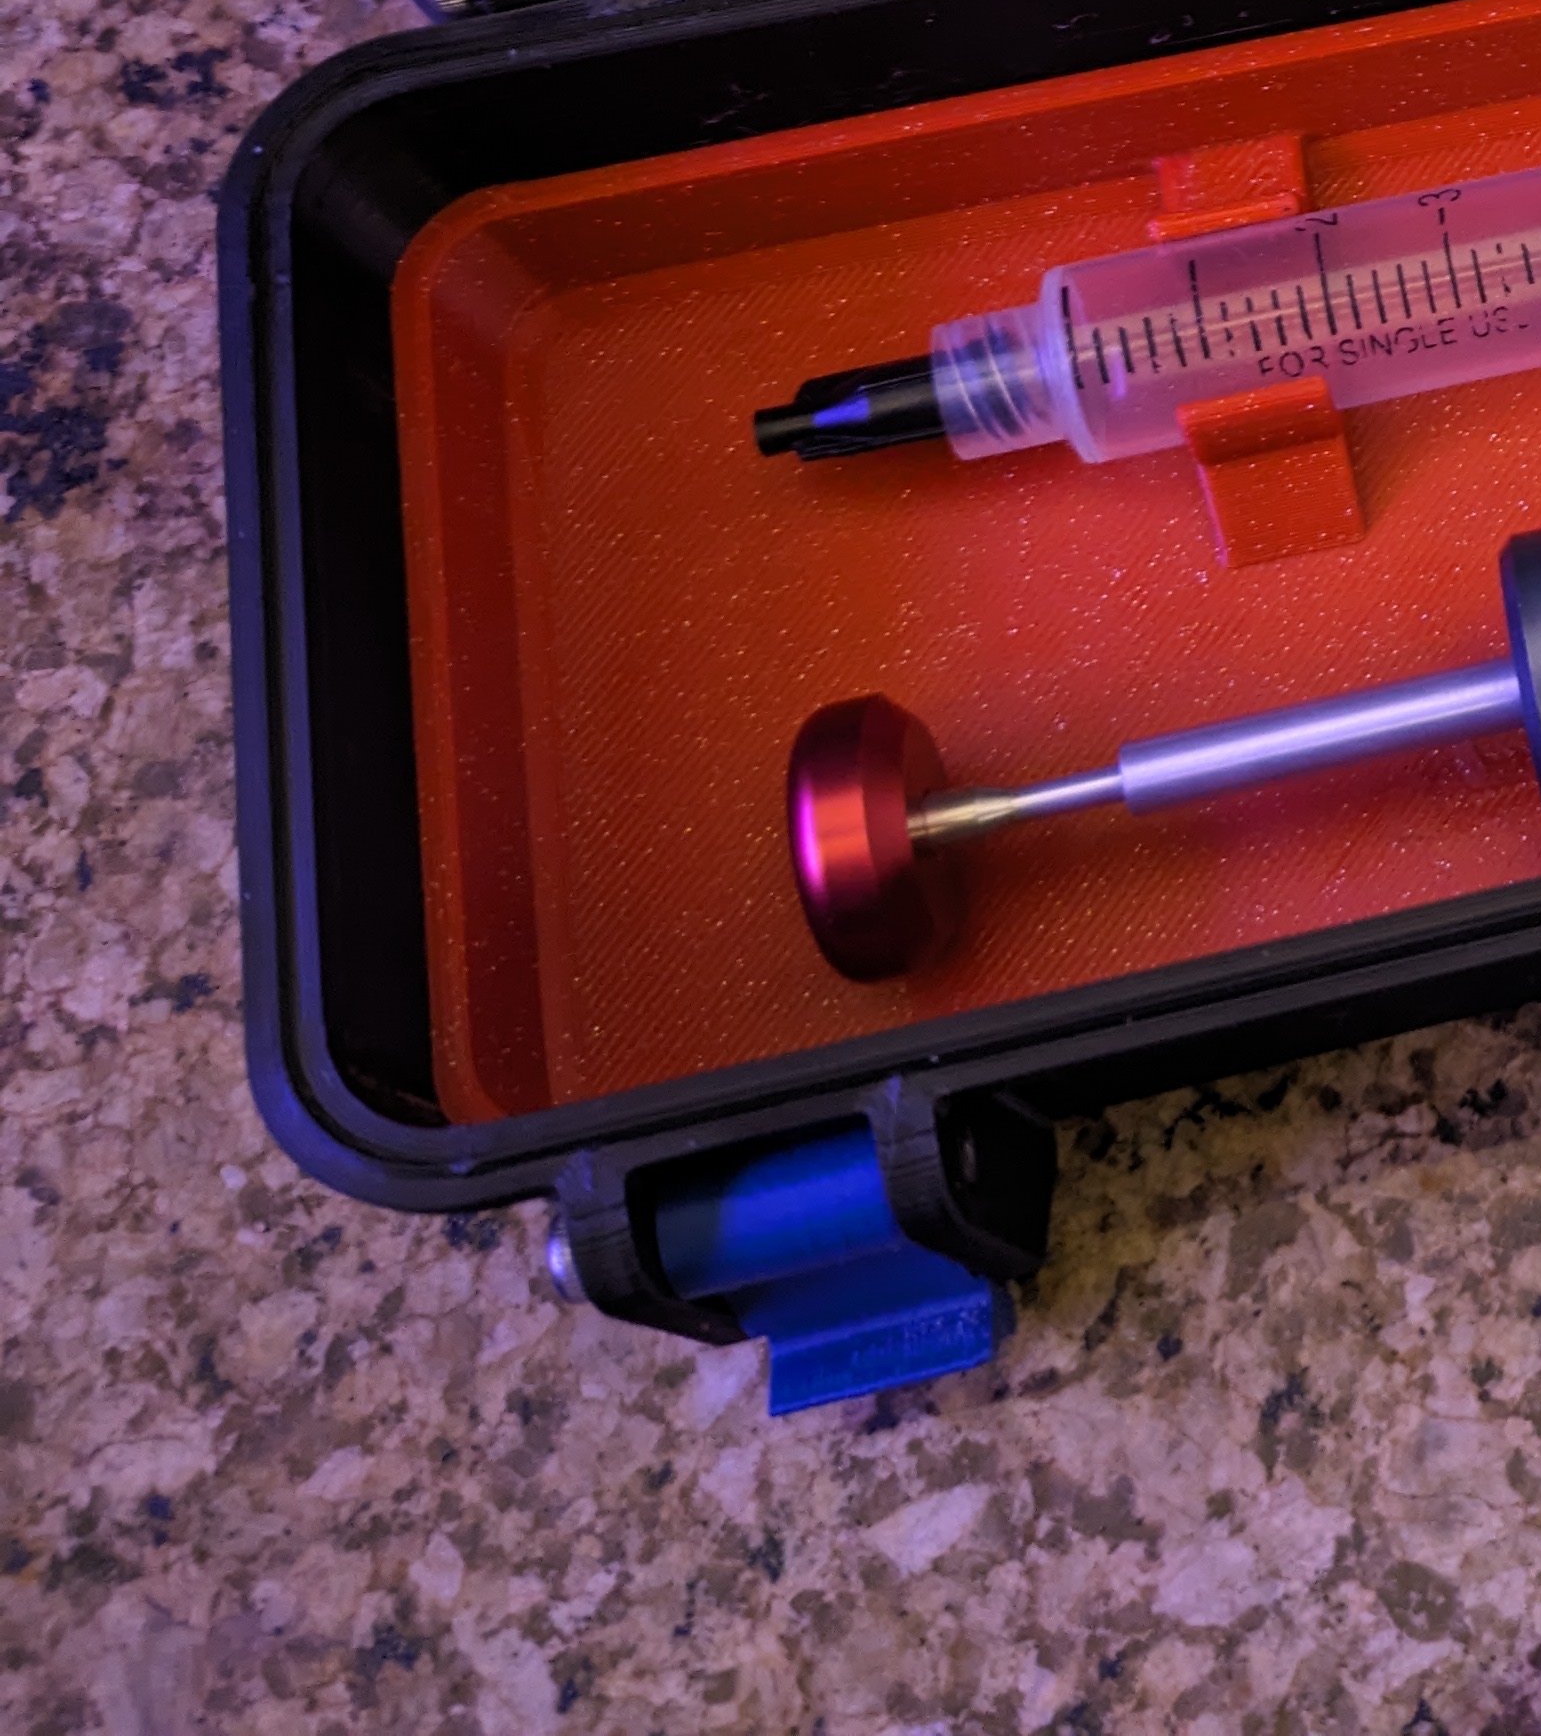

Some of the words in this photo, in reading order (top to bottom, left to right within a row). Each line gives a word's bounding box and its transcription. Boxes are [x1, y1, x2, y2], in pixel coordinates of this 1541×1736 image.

[1417, 188, 1461, 206] 3
[1257, 344, 1329, 377] FOR
[1337, 317, 1459, 365] SINGLE
[1469, 305, 1529, 339] US
